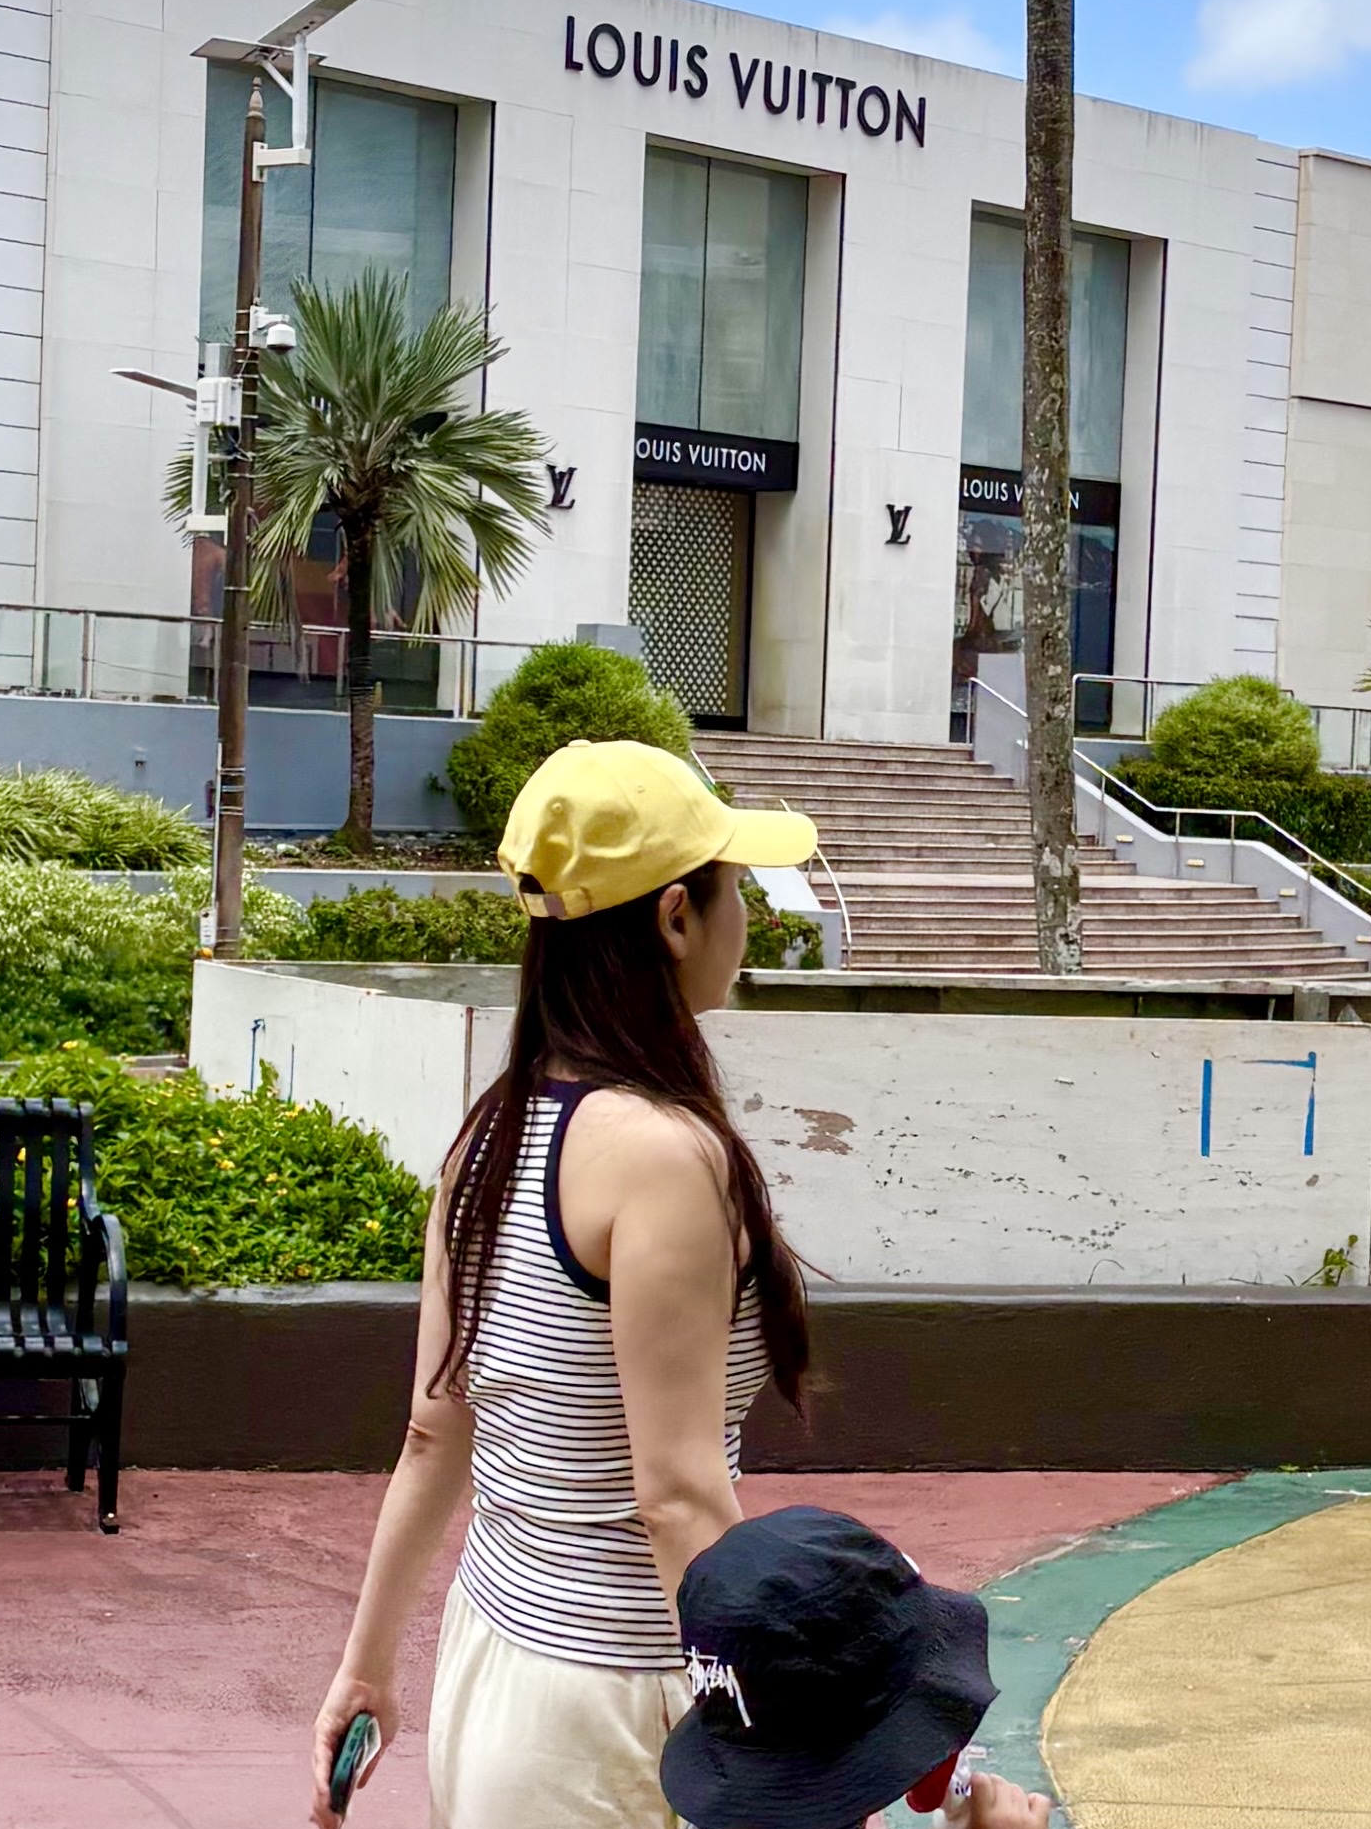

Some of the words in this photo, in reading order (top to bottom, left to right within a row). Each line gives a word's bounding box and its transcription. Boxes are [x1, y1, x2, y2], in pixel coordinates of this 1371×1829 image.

[564, 15, 709, 99] LOUIS
[729, 52, 927, 148] VUITTON
[688, 443, 768, 473] VUITTON
[963, 478, 1009, 502] LOUIS
